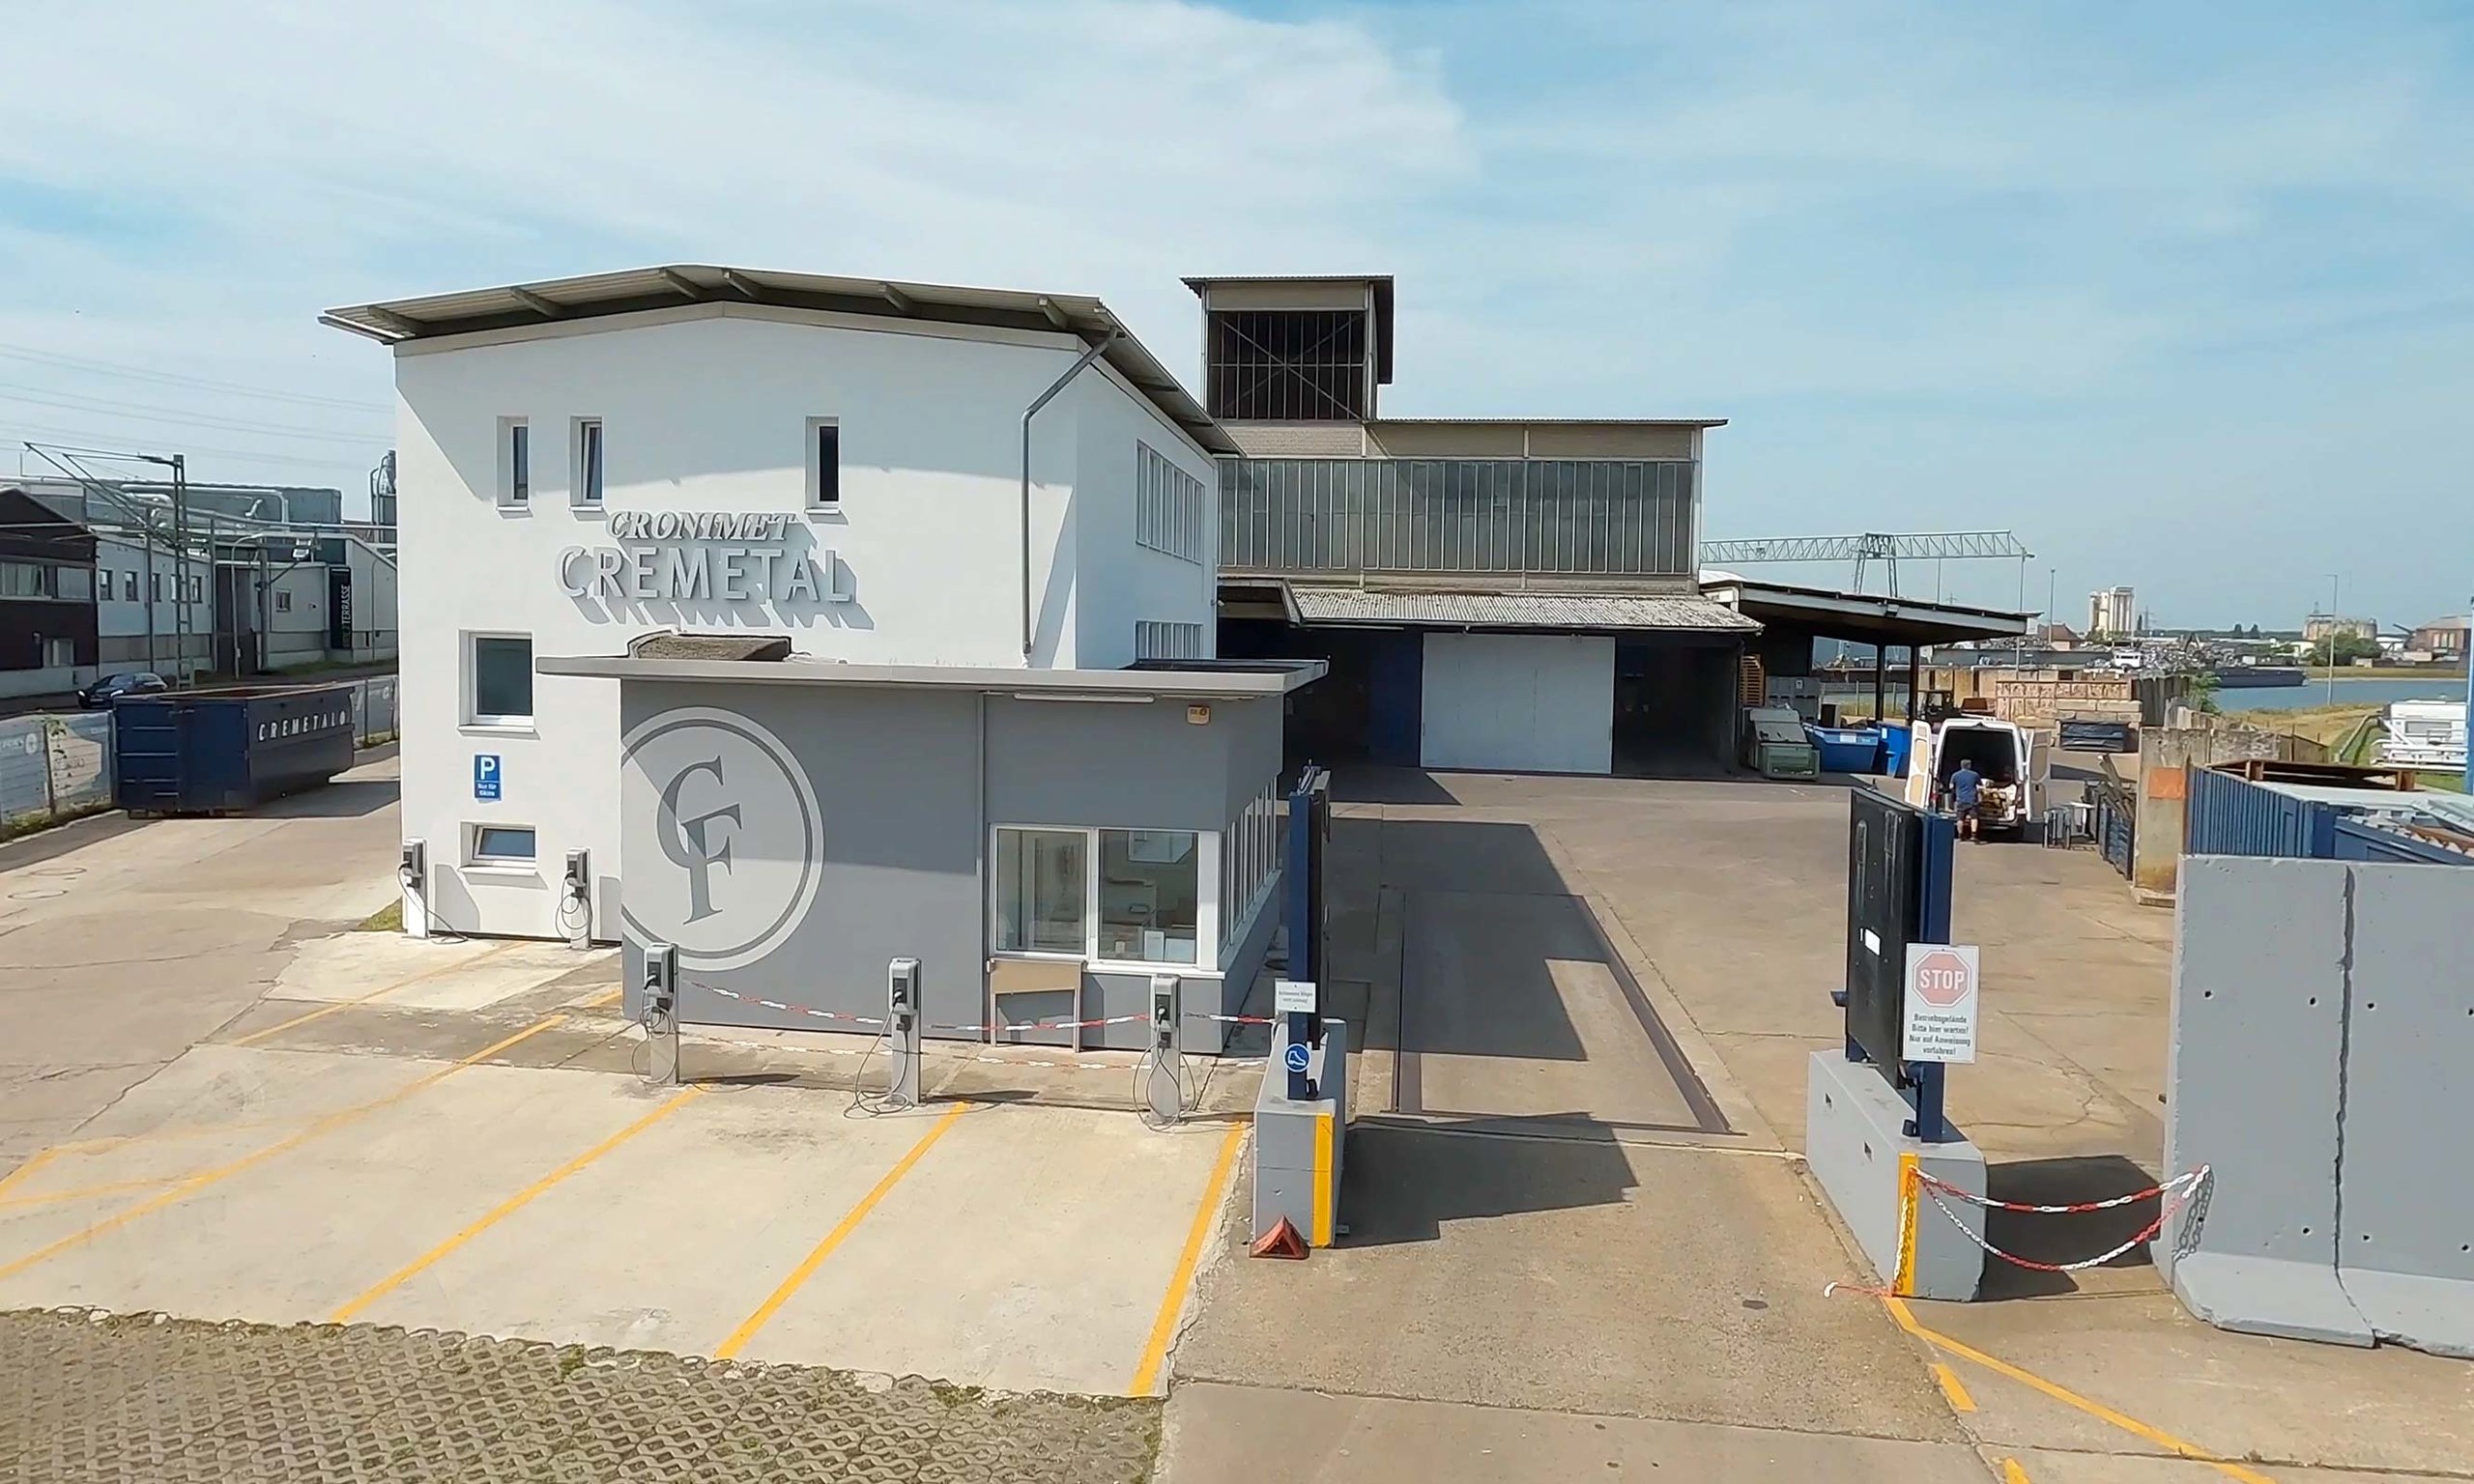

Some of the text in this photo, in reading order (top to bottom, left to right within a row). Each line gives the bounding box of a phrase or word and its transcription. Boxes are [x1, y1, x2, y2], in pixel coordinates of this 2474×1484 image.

[606, 510, 797, 541] CRONIMET
[555, 545, 851, 603] CREMETAL
[480, 756, 496, 780] P
[1920, 968, 1965, 990] STOP
[1912, 1023, 1927, 1032] Bitte
[1929, 1024, 1942, 1033] hier
